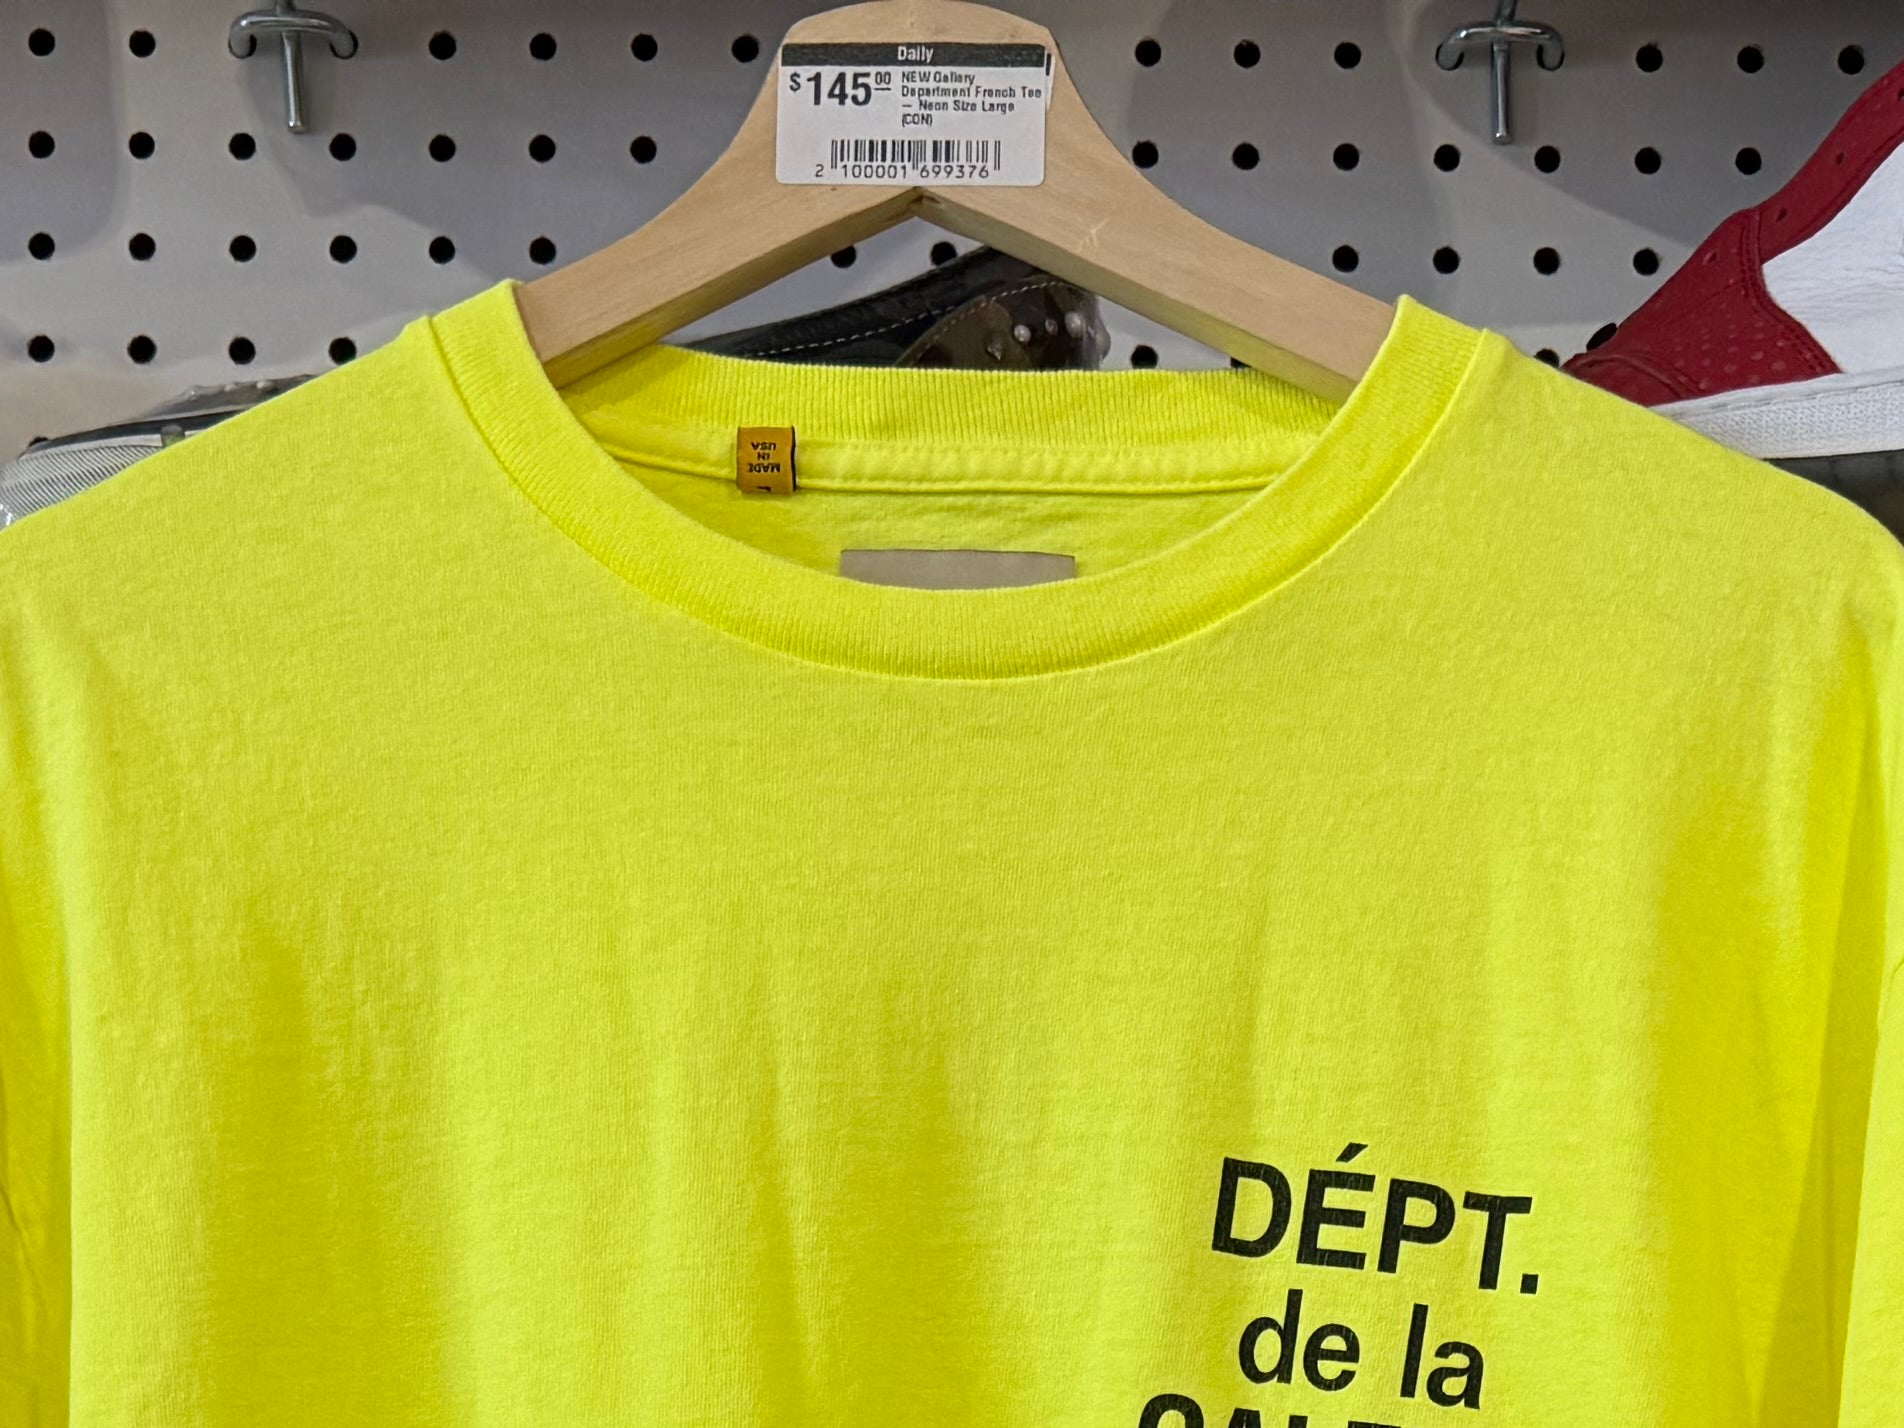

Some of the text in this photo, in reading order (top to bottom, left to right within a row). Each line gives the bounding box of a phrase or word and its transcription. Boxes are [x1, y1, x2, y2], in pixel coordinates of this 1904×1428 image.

[897, 45, 934, 64] Daily
[901, 71, 976, 86] NEW Gallery
[901, 85, 1043, 101] Department French Tee
[918, 100, 949, 112] Neon
[952, 100, 978, 112] Size
[982, 101, 1015, 115] Large
[901, 113, 934, 127] (CON)
[1211, 1142, 1540, 1295] DÉPT.
[1238, 1288, 1485, 1410] de la
